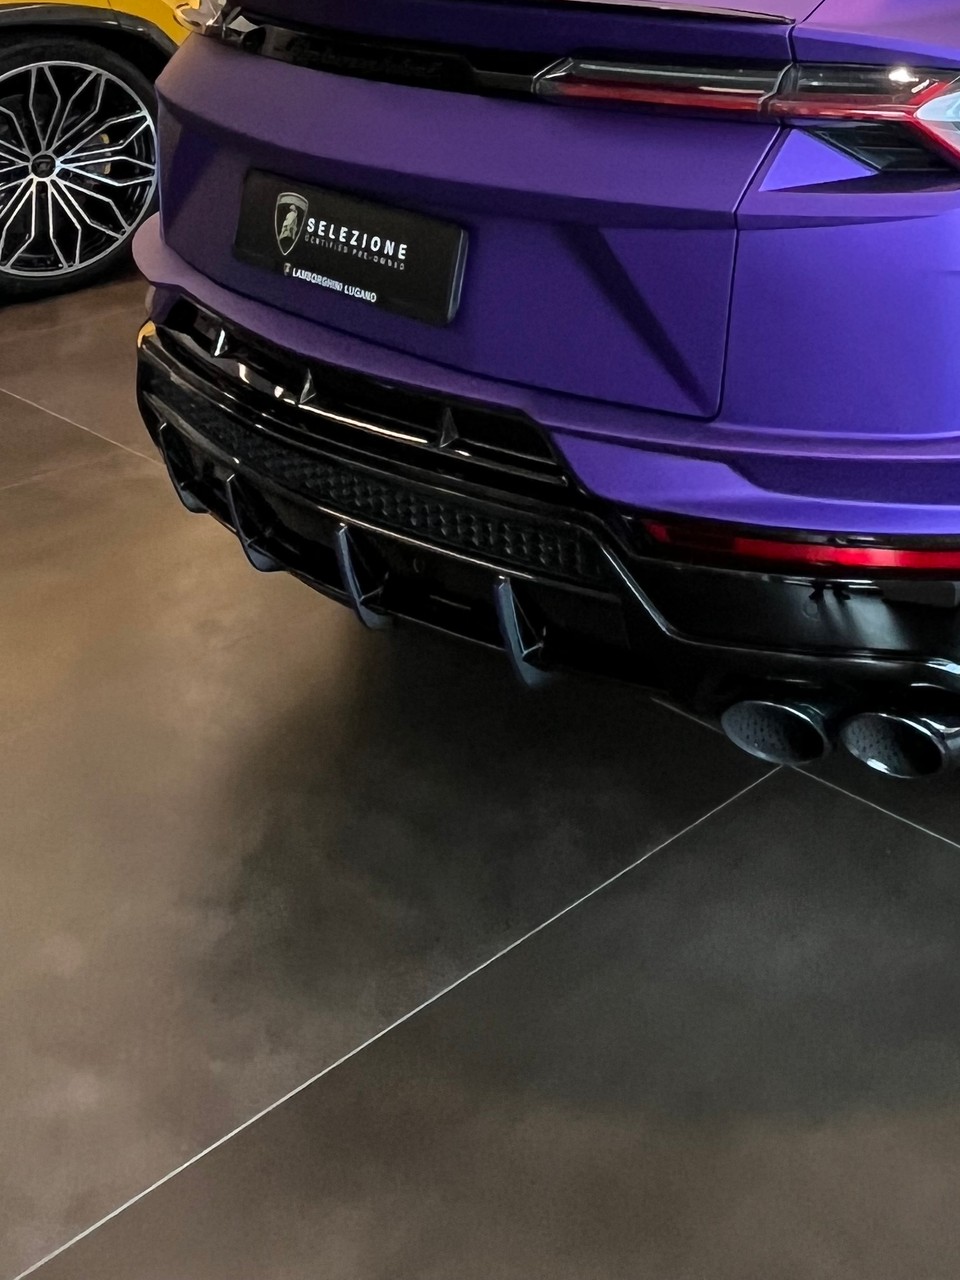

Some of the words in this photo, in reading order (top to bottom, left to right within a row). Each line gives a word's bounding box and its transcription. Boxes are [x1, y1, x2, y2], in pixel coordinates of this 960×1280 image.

[306, 218, 408, 260] SELEZIONE
[292, 267, 343, 292] LAMBORGHINI
[344, 284, 377, 303] LUGANO
